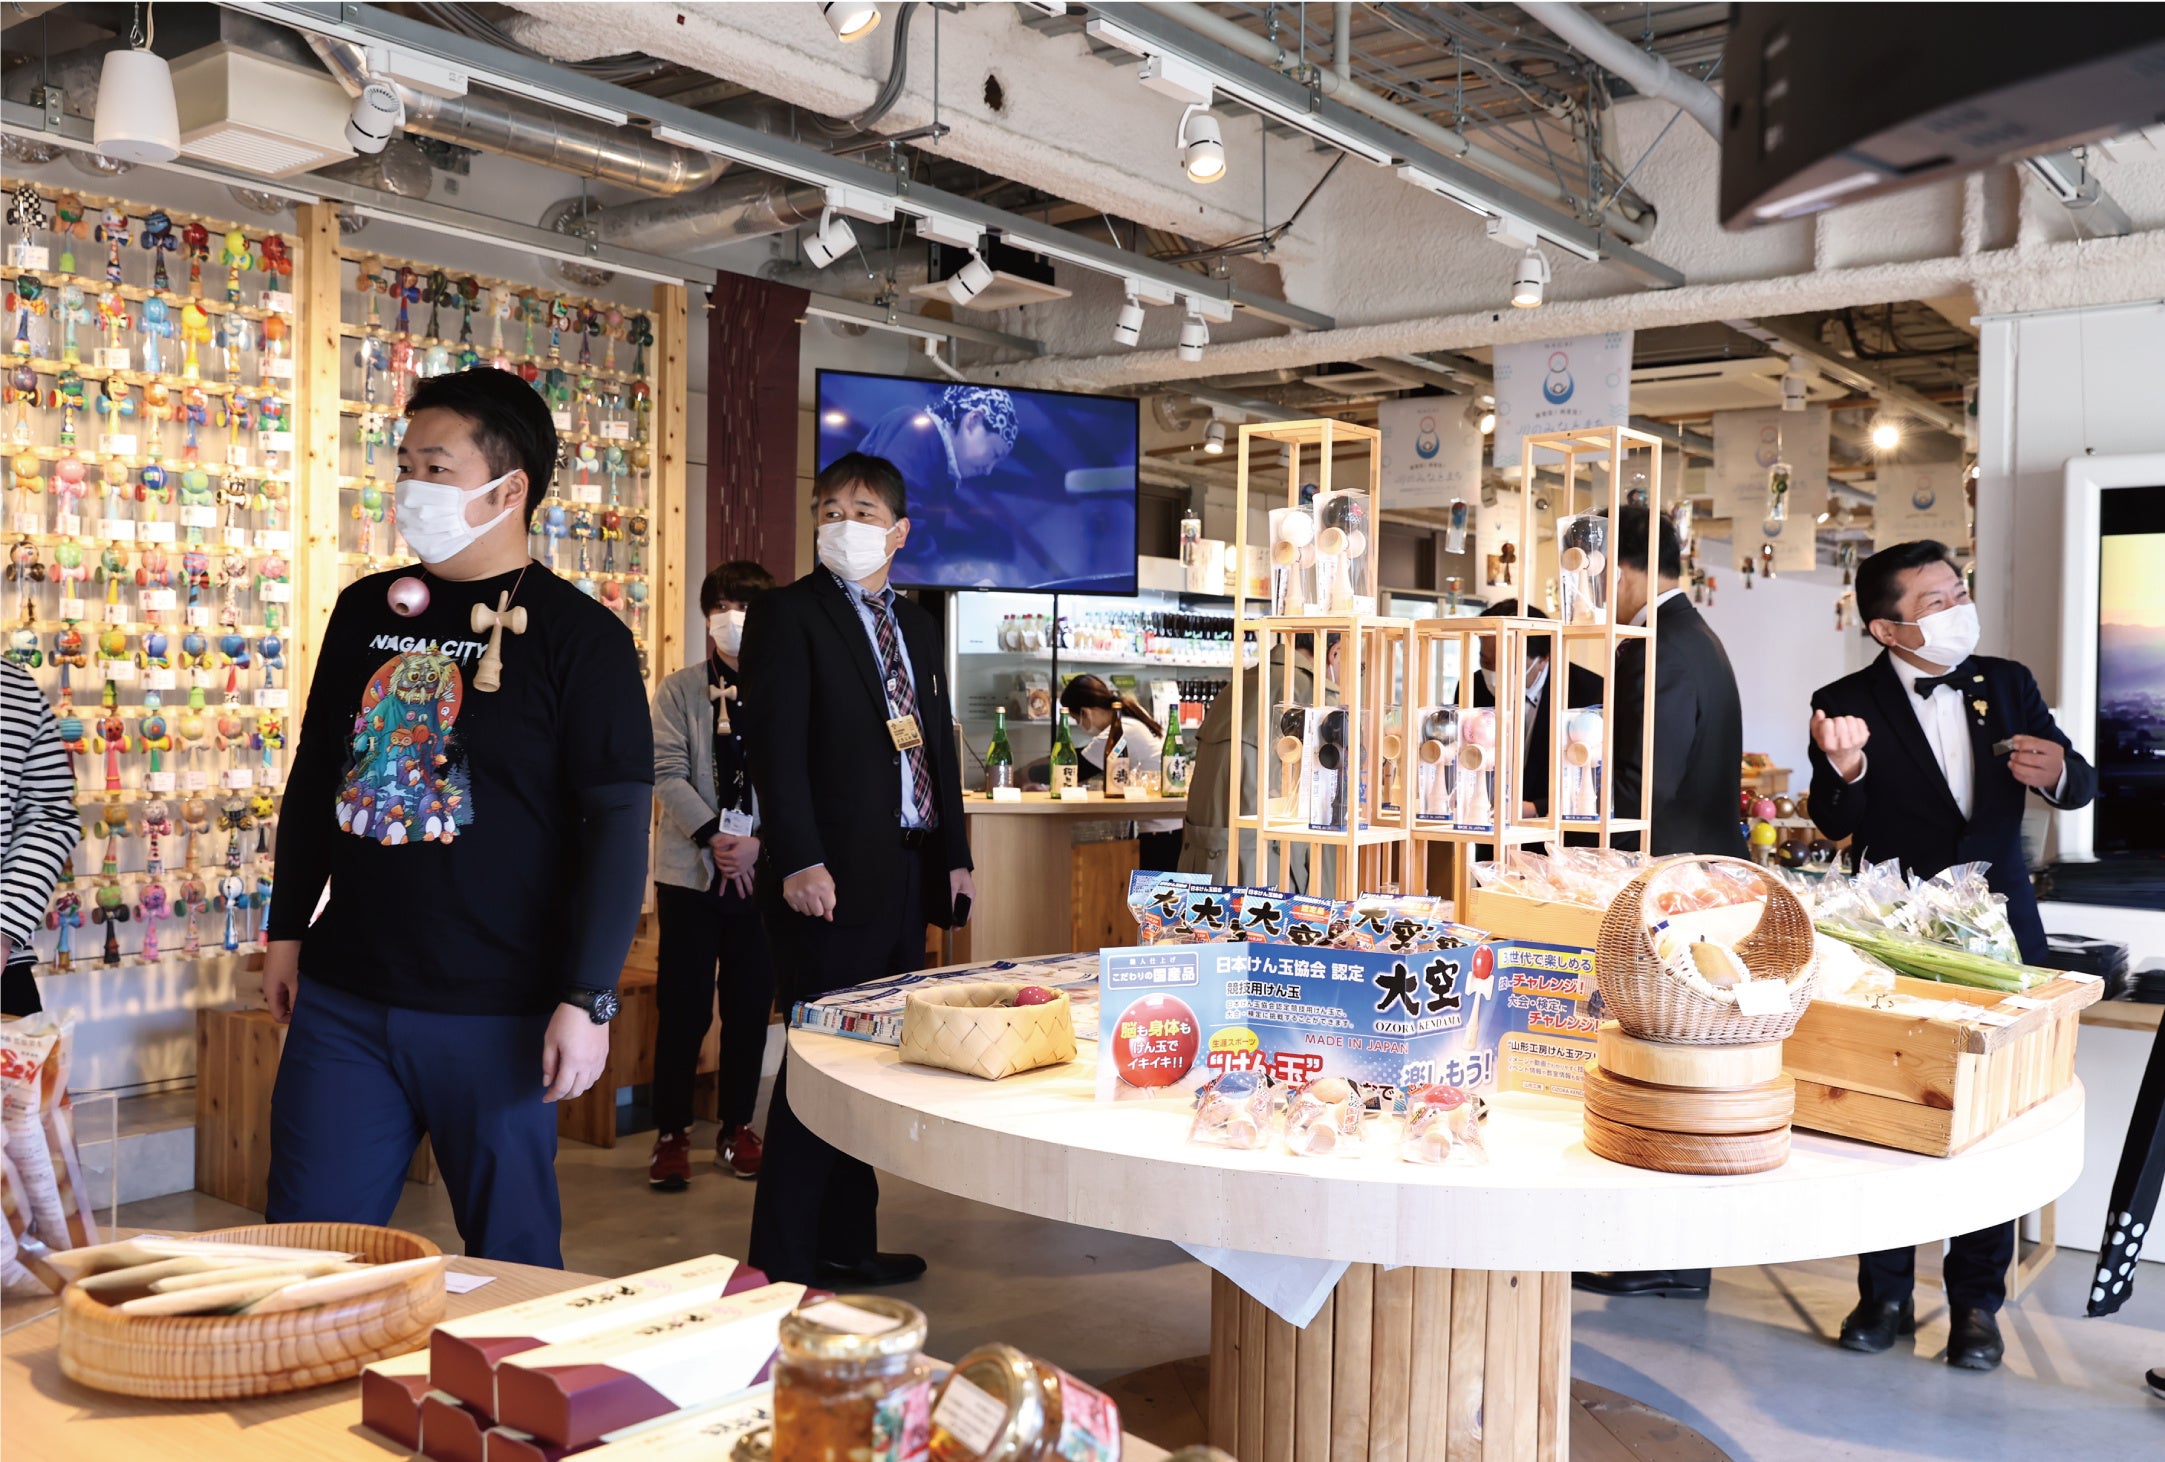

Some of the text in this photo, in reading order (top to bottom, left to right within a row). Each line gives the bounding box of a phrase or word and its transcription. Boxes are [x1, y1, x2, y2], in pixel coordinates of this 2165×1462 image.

[440, 640, 489, 660] CITY
[1112, 966, 1195, 983] こだわりの国産品
[1216, 956, 1365, 983] 日本けん玉協会 認定
[1226, 980, 1301, 1000] 競技用けん玉
[1374, 958, 1460, 1016] 大空
[1120, 1019, 1191, 1039] 脳も身体も
[1375, 1016, 1462, 1034] OZORA KENDAMA
[1133, 1040, 1179, 1053] けん玉で
[1212, 1038, 1256, 1048] 生涯スポーツ
[1305, 1034, 1409, 1054] MADE IN JAPAN
[1128, 1056, 1184, 1070] イキイキ!!
